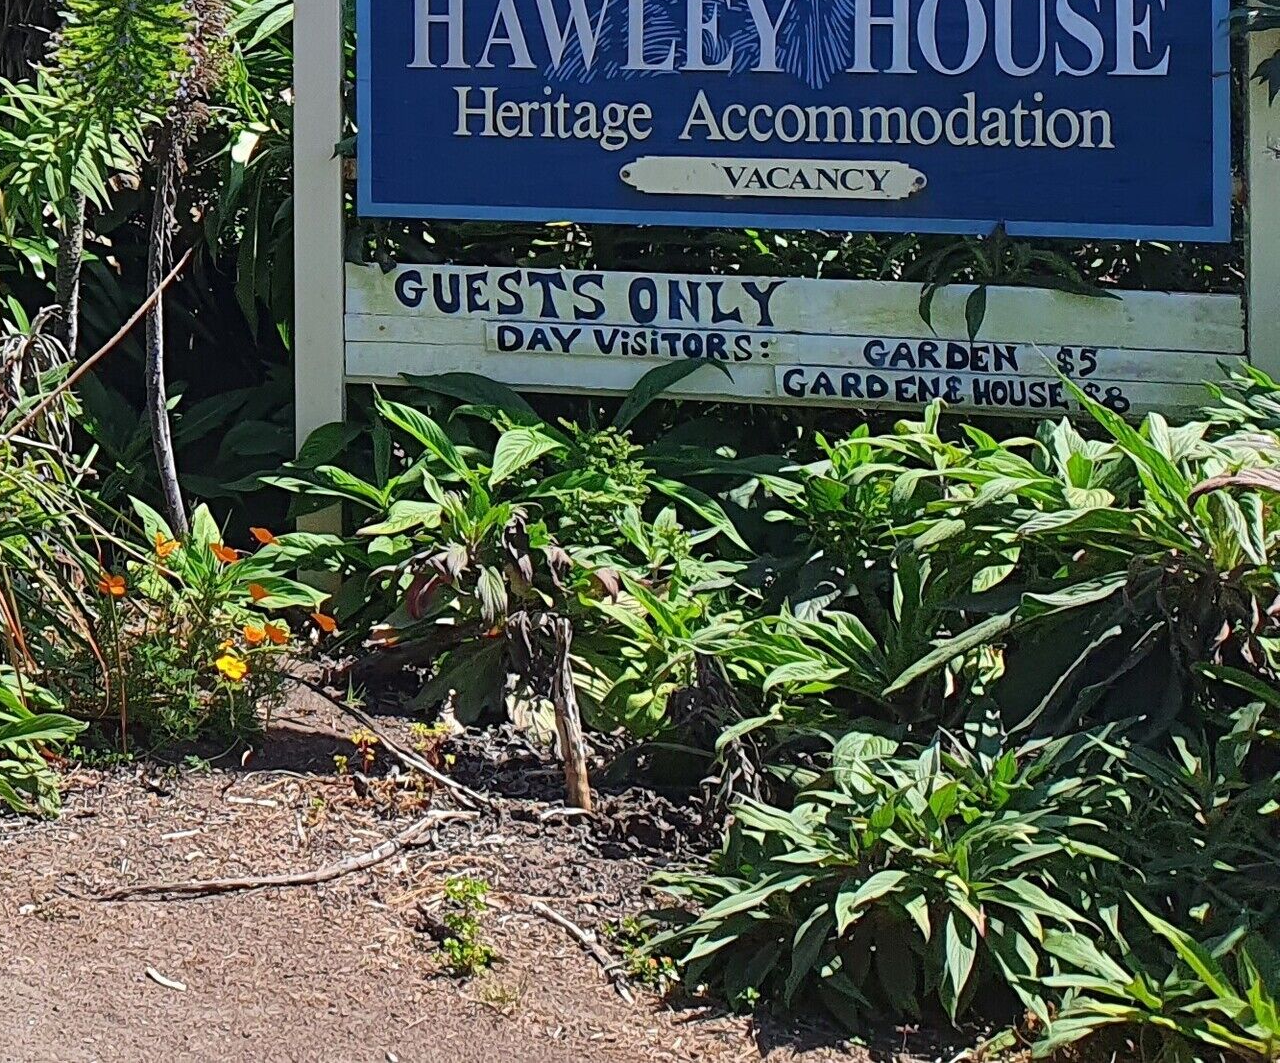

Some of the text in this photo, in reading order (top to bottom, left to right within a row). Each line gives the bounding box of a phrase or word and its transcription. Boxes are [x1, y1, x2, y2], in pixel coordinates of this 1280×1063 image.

[453, 85, 1115, 151] Heritage Accommodation
[722, 166, 891, 192] VACANCY
[394, 269, 787, 327] GUESTS ONLY
[497, 325, 582, 354] DAY
[863, 340, 1019, 372] GARDEN
[1056, 346, 1099, 378] $5
[972, 377, 1070, 411] HOUSE
